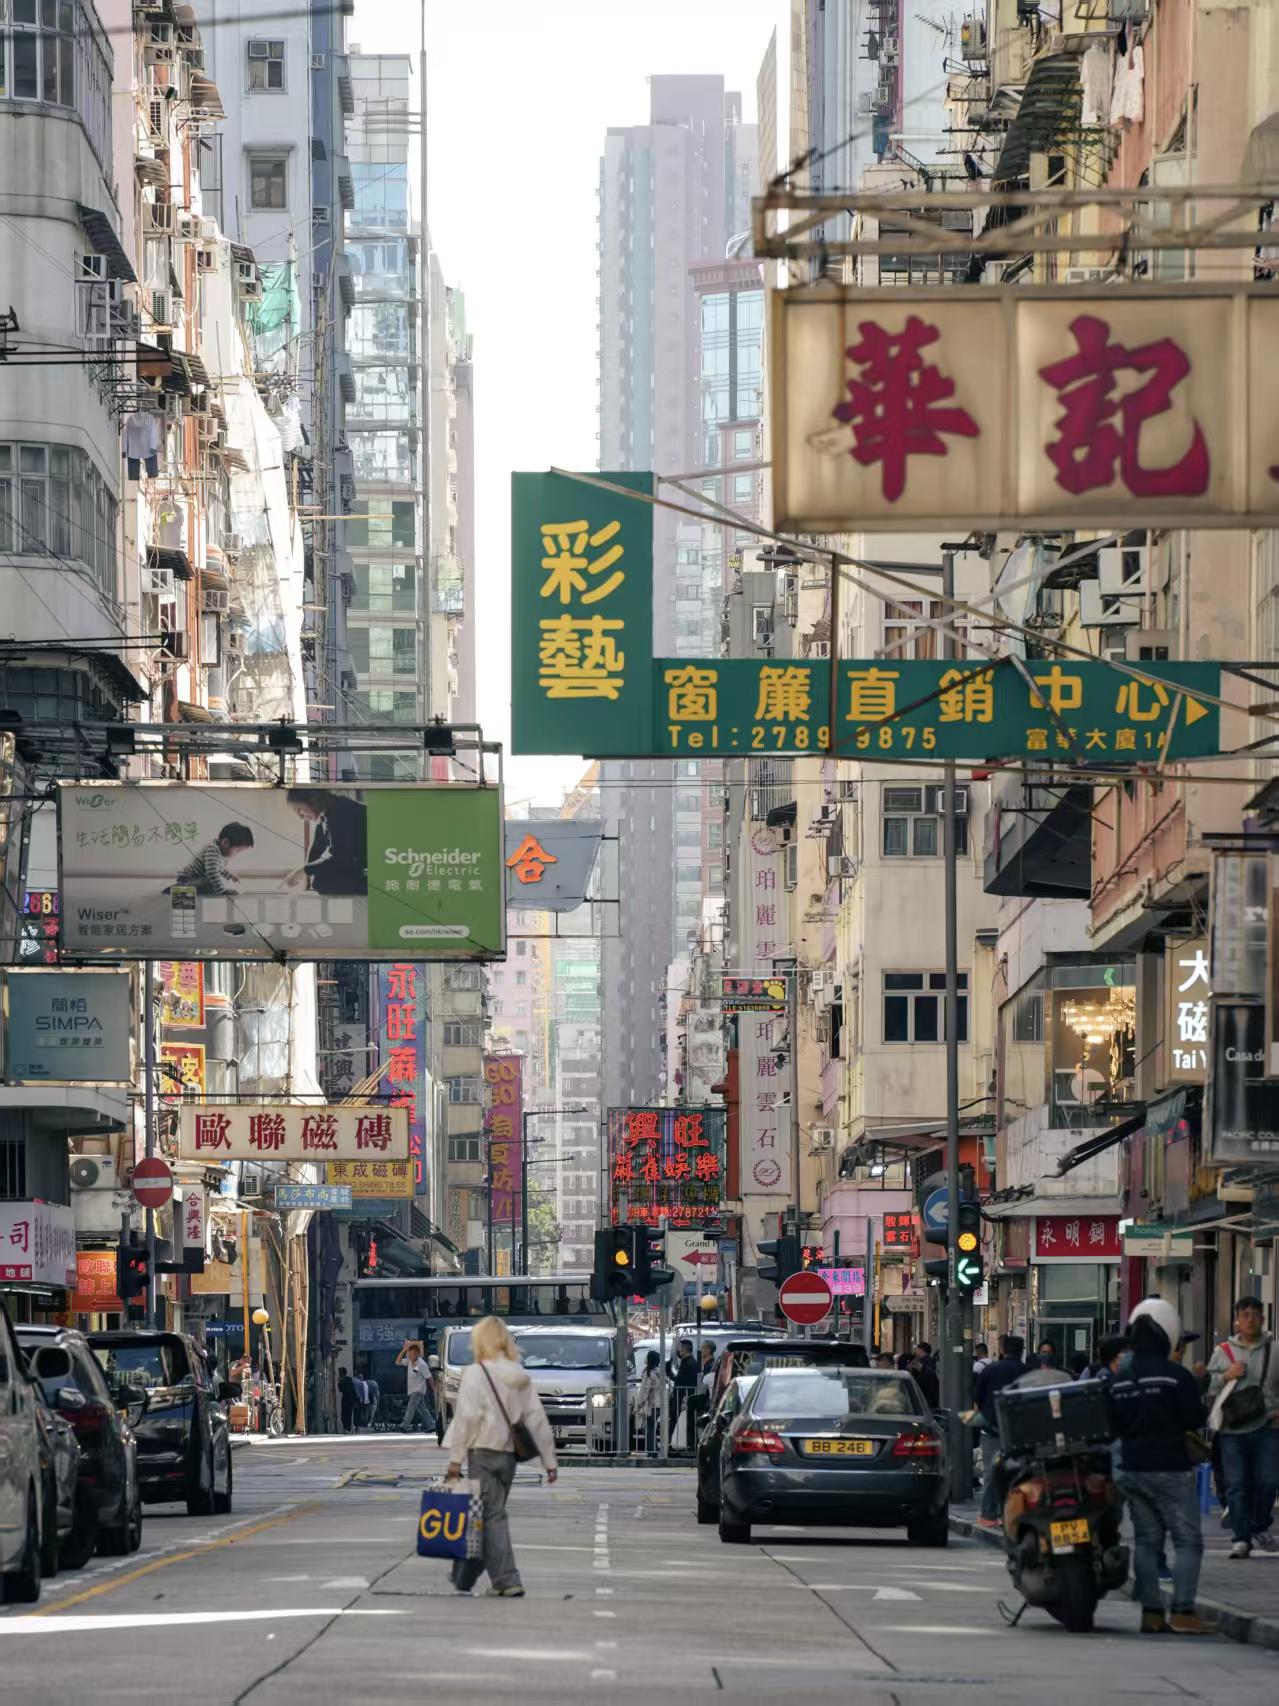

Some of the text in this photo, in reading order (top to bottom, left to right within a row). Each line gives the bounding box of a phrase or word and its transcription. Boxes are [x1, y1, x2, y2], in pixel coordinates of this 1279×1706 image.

[833, 314, 1279, 503] 華記
[539, 519, 625, 700] 彩藝
[668, 725, 738, 748] Tel:
[384, 848, 481, 864] Schneider
[426, 864, 481, 875] Electric
[79, 924, 153, 937] 智能家居方案
[36, 1016, 103, 1030] SIMPA
[1173, 1049, 1196, 1068] Tai
[1225, 1047, 1253, 1062] Casa
[195, 1113, 392, 1150] 歐聯磁磚
[624, 1112, 709, 1149] 興旺
[685, 1240, 710, 1248] Grand
[79, 1278, 117, 1295] 請上
[420, 1508, 465, 1541] GU
